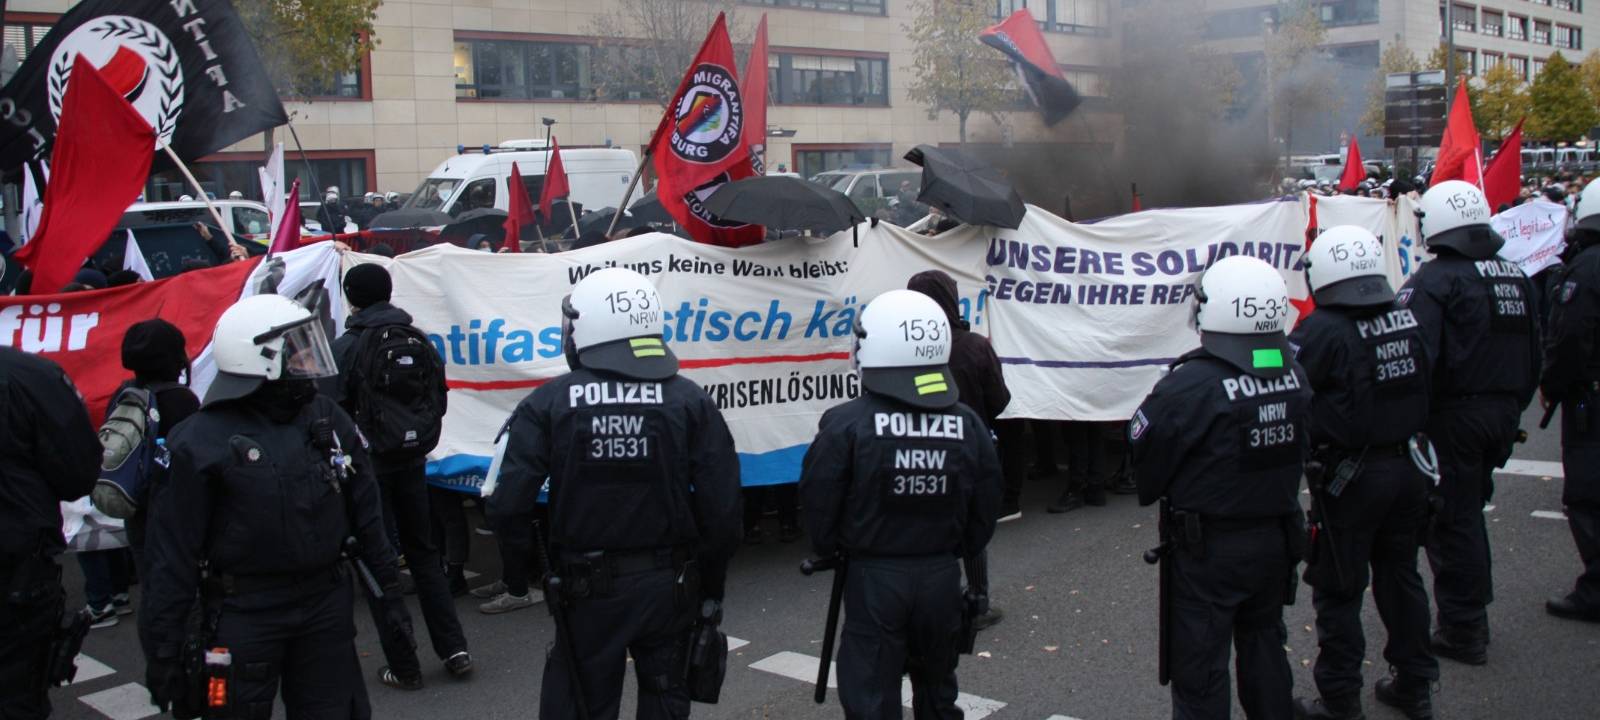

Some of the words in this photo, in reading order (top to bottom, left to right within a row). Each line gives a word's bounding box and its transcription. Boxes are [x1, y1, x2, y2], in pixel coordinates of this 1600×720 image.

[694, 70, 744, 146] MIGRANTIFA
[671, 132, 709, 158] BURG
[668, 253, 725, 275] keine
[986, 237, 1125, 276] UNSERE
[986, 275, 1072, 305] GEGEN
[1077, 283, 1145, 306] IHRE
[1150, 283, 1195, 305] REP
[1494, 283, 1520, 298] NRW
[629, 311, 658, 325] NRW
[1498, 300, 1526, 315] 31531
[0, 303, 99, 353] für
[1254, 319, 1280, 331] NRW
[1356, 309, 1418, 339] POLIZEI
[915, 345, 945, 358] NRW
[1376, 339, 1410, 360] NRW
[1376, 358, 1416, 381] 31533
[569, 382, 664, 408] POLIZEI
[704, 371, 862, 410] KRISENLÖSUNG
[1258, 402, 1287, 423] NRW
[591, 415, 644, 435] NRW
[874, 412, 964, 440] POLIZEI
[1250, 424, 1295, 448] 31533
[591, 436, 648, 458] 31531
[894, 448, 946, 469] NRW
[893, 475, 947, 495] 31531
